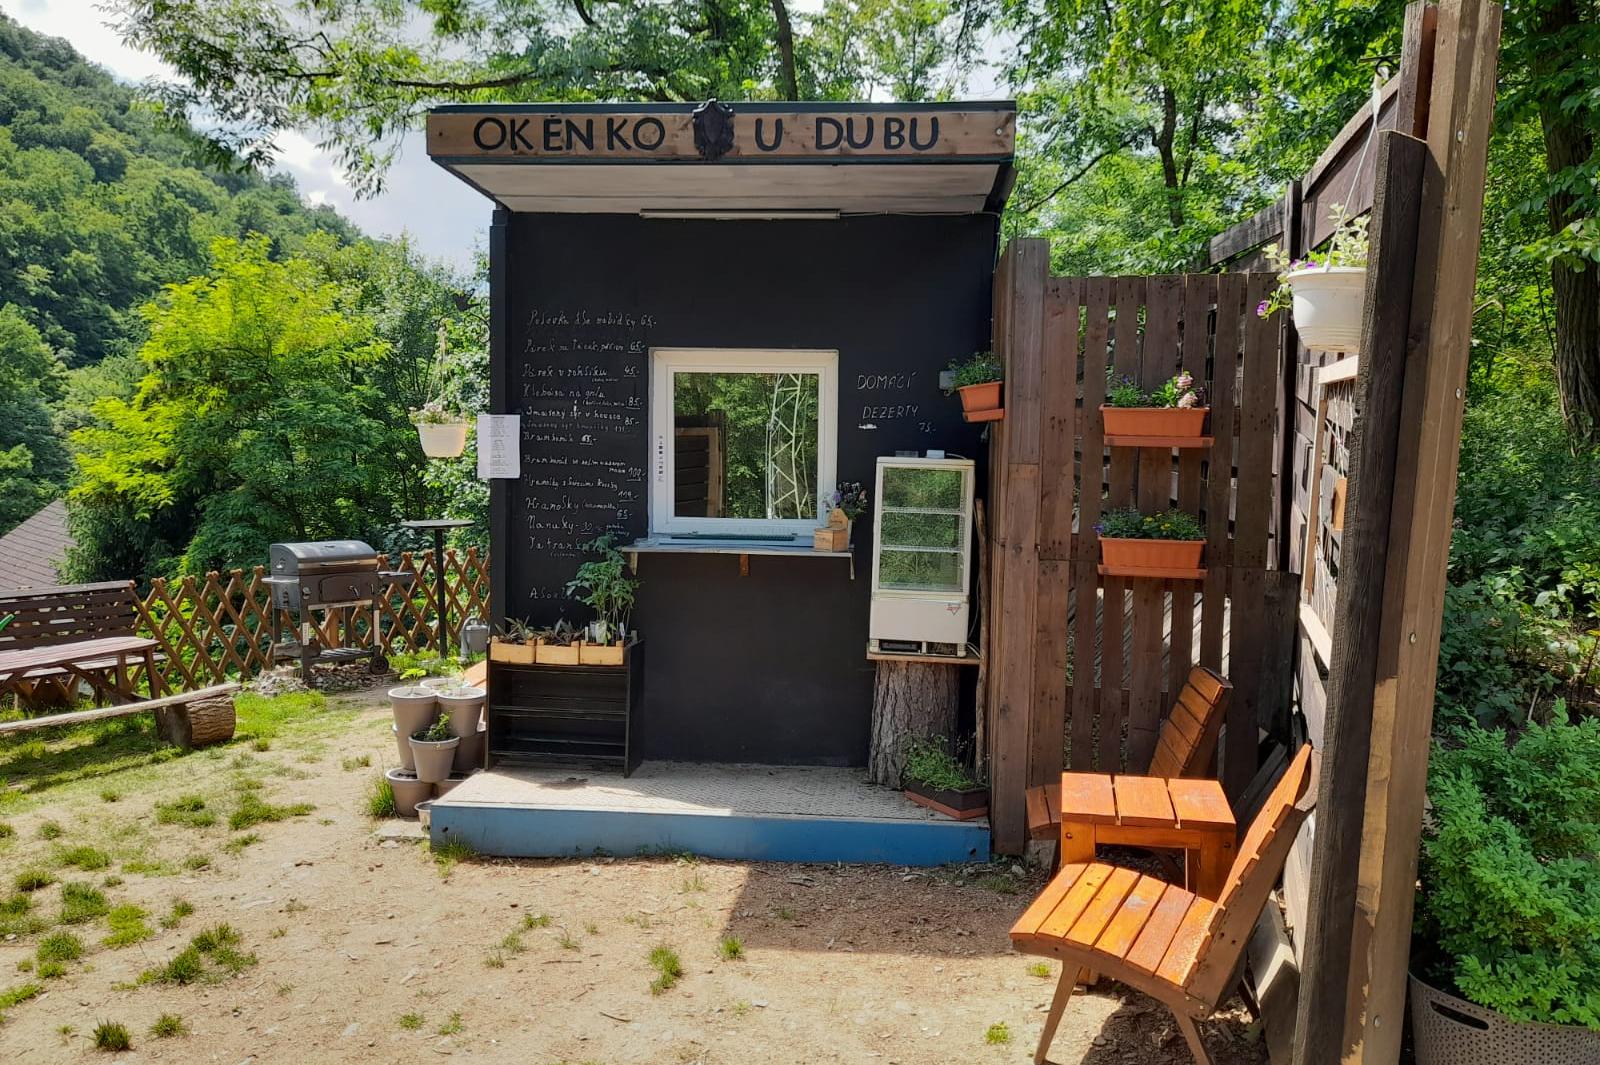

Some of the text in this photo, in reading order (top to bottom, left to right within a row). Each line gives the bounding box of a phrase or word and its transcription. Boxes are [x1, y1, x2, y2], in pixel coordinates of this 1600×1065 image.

[473, 113, 940, 152] OKÉNKO U DUBU
[862, 405, 919, 420] DEZERTY
